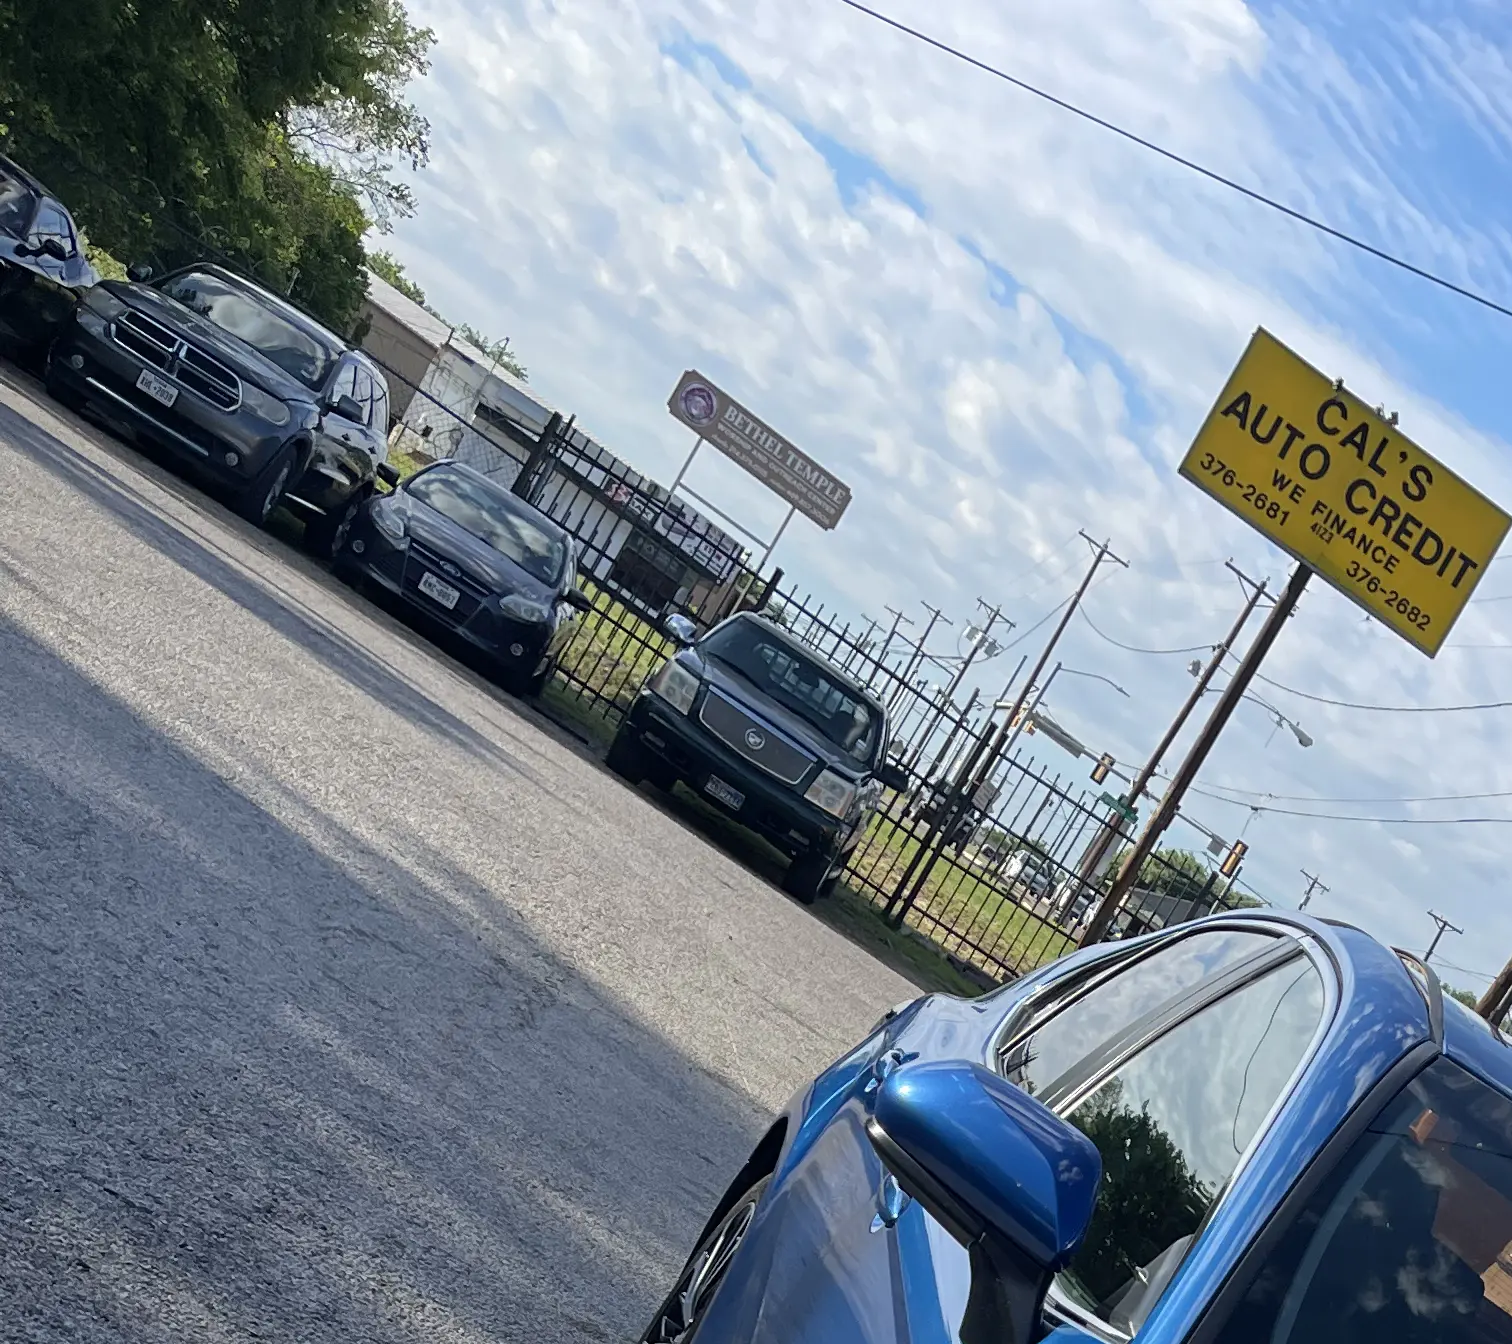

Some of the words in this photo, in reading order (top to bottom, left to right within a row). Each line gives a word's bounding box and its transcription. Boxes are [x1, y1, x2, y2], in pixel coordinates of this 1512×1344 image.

[724, 405, 784, 460] BETHEL
[787, 450, 847, 505] TEMPLE
[751, 449, 768, 464] AND
[1221, 391, 1331, 480] AUTO
[1344, 478, 1479, 589] CREDIT
[1316, 398, 1433, 502] CAL'S
[1200, 452, 1290, 526] 376-2681
[1345, 560, 1431, 632] 376-2682
[1272, 469, 1306, 505] WE
[1310, 500, 1400, 574] FINANCE
